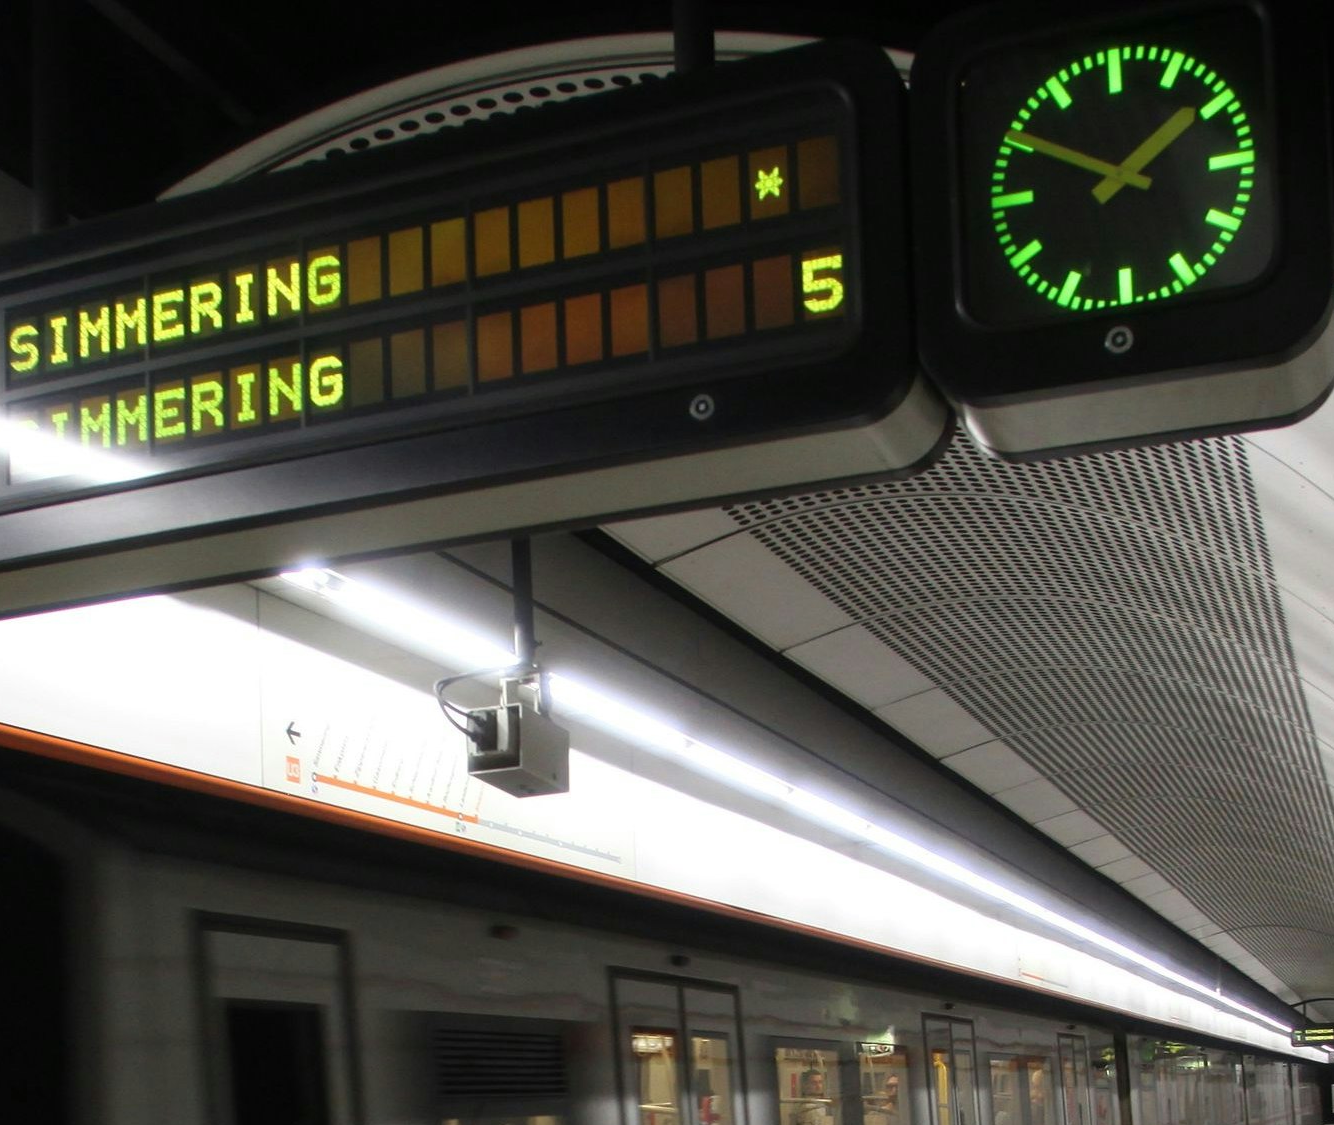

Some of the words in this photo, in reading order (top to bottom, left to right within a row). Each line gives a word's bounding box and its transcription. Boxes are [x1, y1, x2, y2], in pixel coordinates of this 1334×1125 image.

[9, 254, 342, 373] SIMMERING
[12, 355, 344, 448] IMMERING
[801, 254, 844, 314] 5
